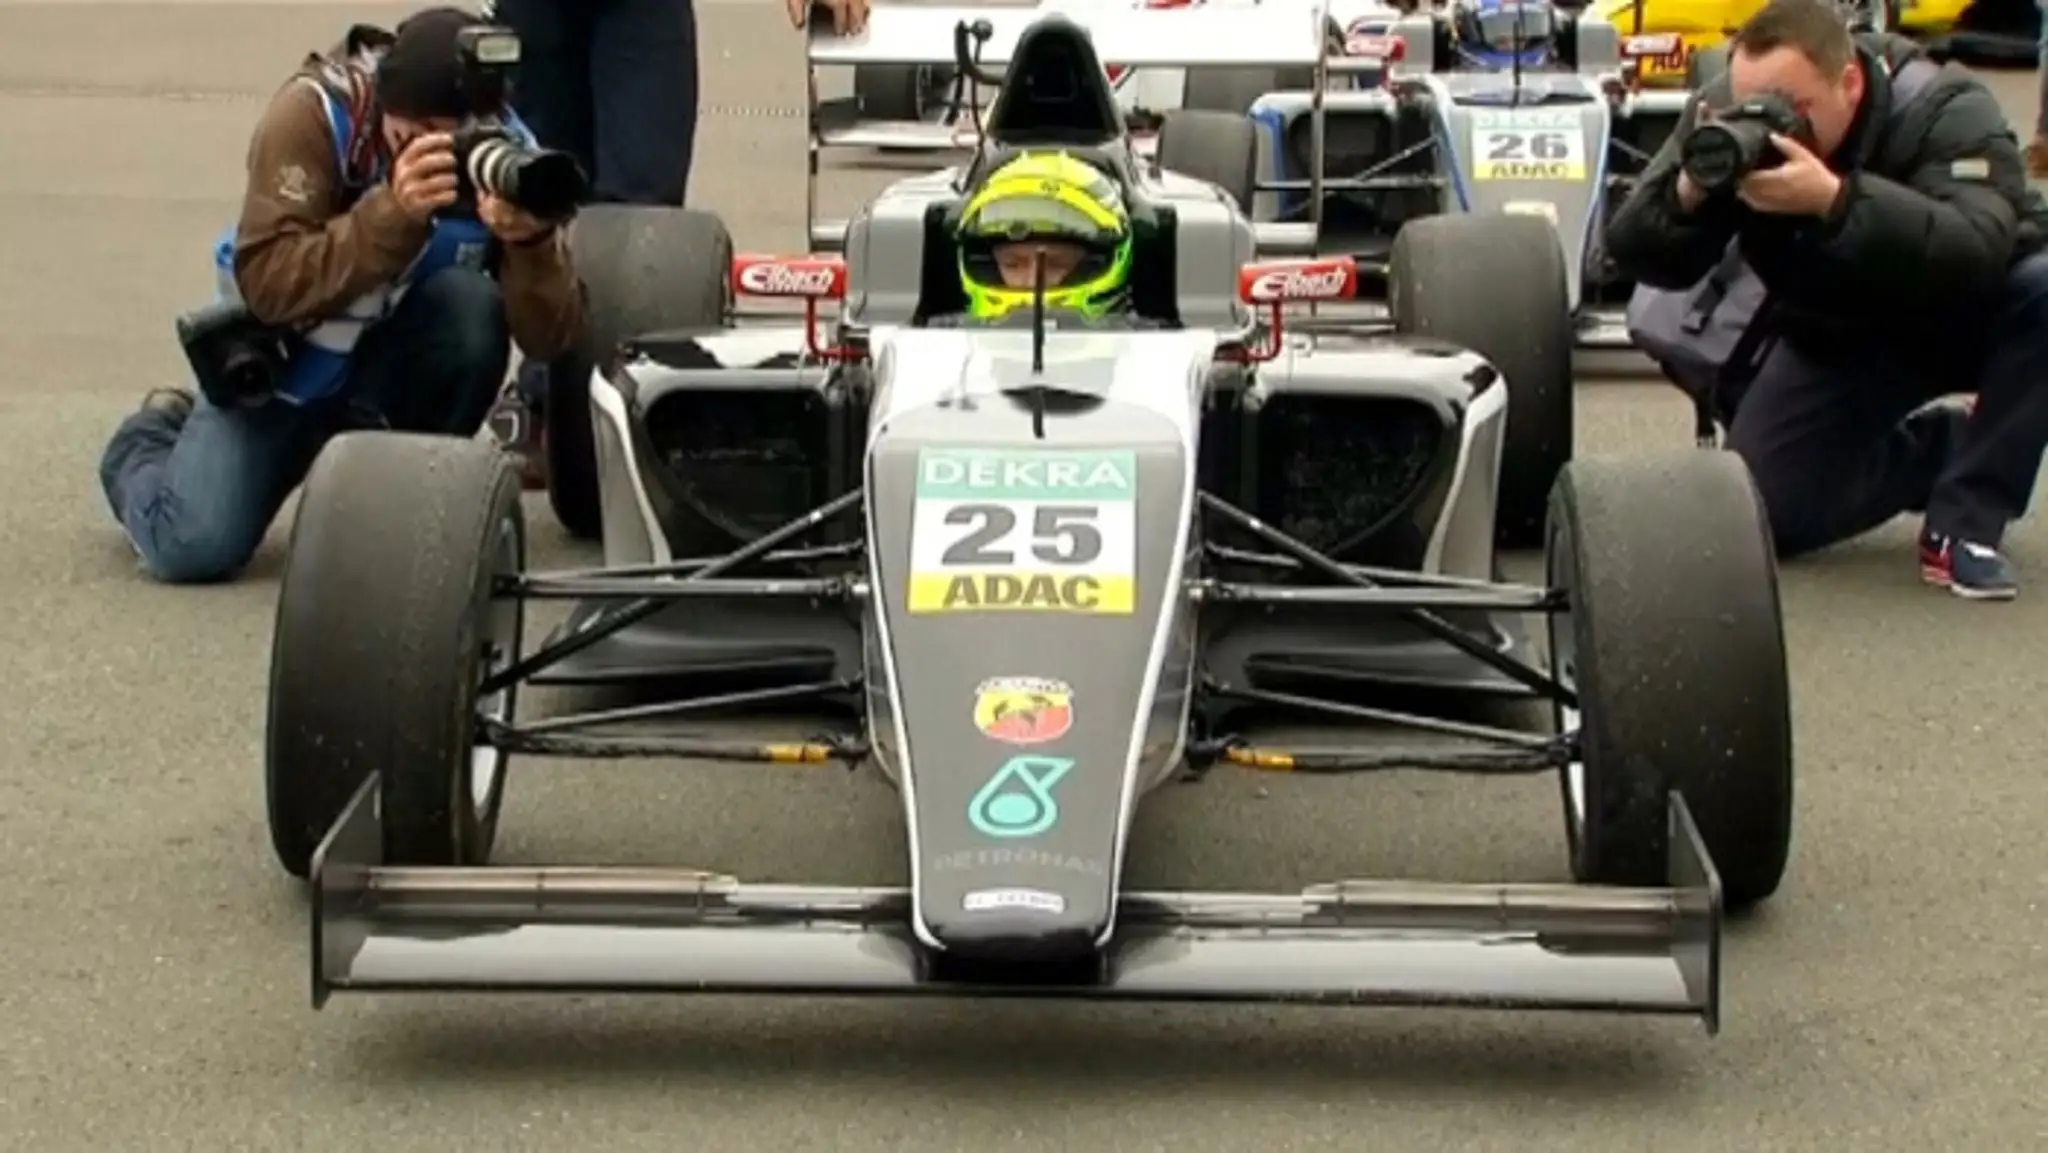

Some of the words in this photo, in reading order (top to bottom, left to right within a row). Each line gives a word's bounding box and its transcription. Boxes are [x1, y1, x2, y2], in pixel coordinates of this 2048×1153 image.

[1488, 133, 1569, 160] 26
[923, 456, 1129, 490] DEKRA
[941, 503, 1102, 565] 25
[942, 573, 1102, 609] ADAC
